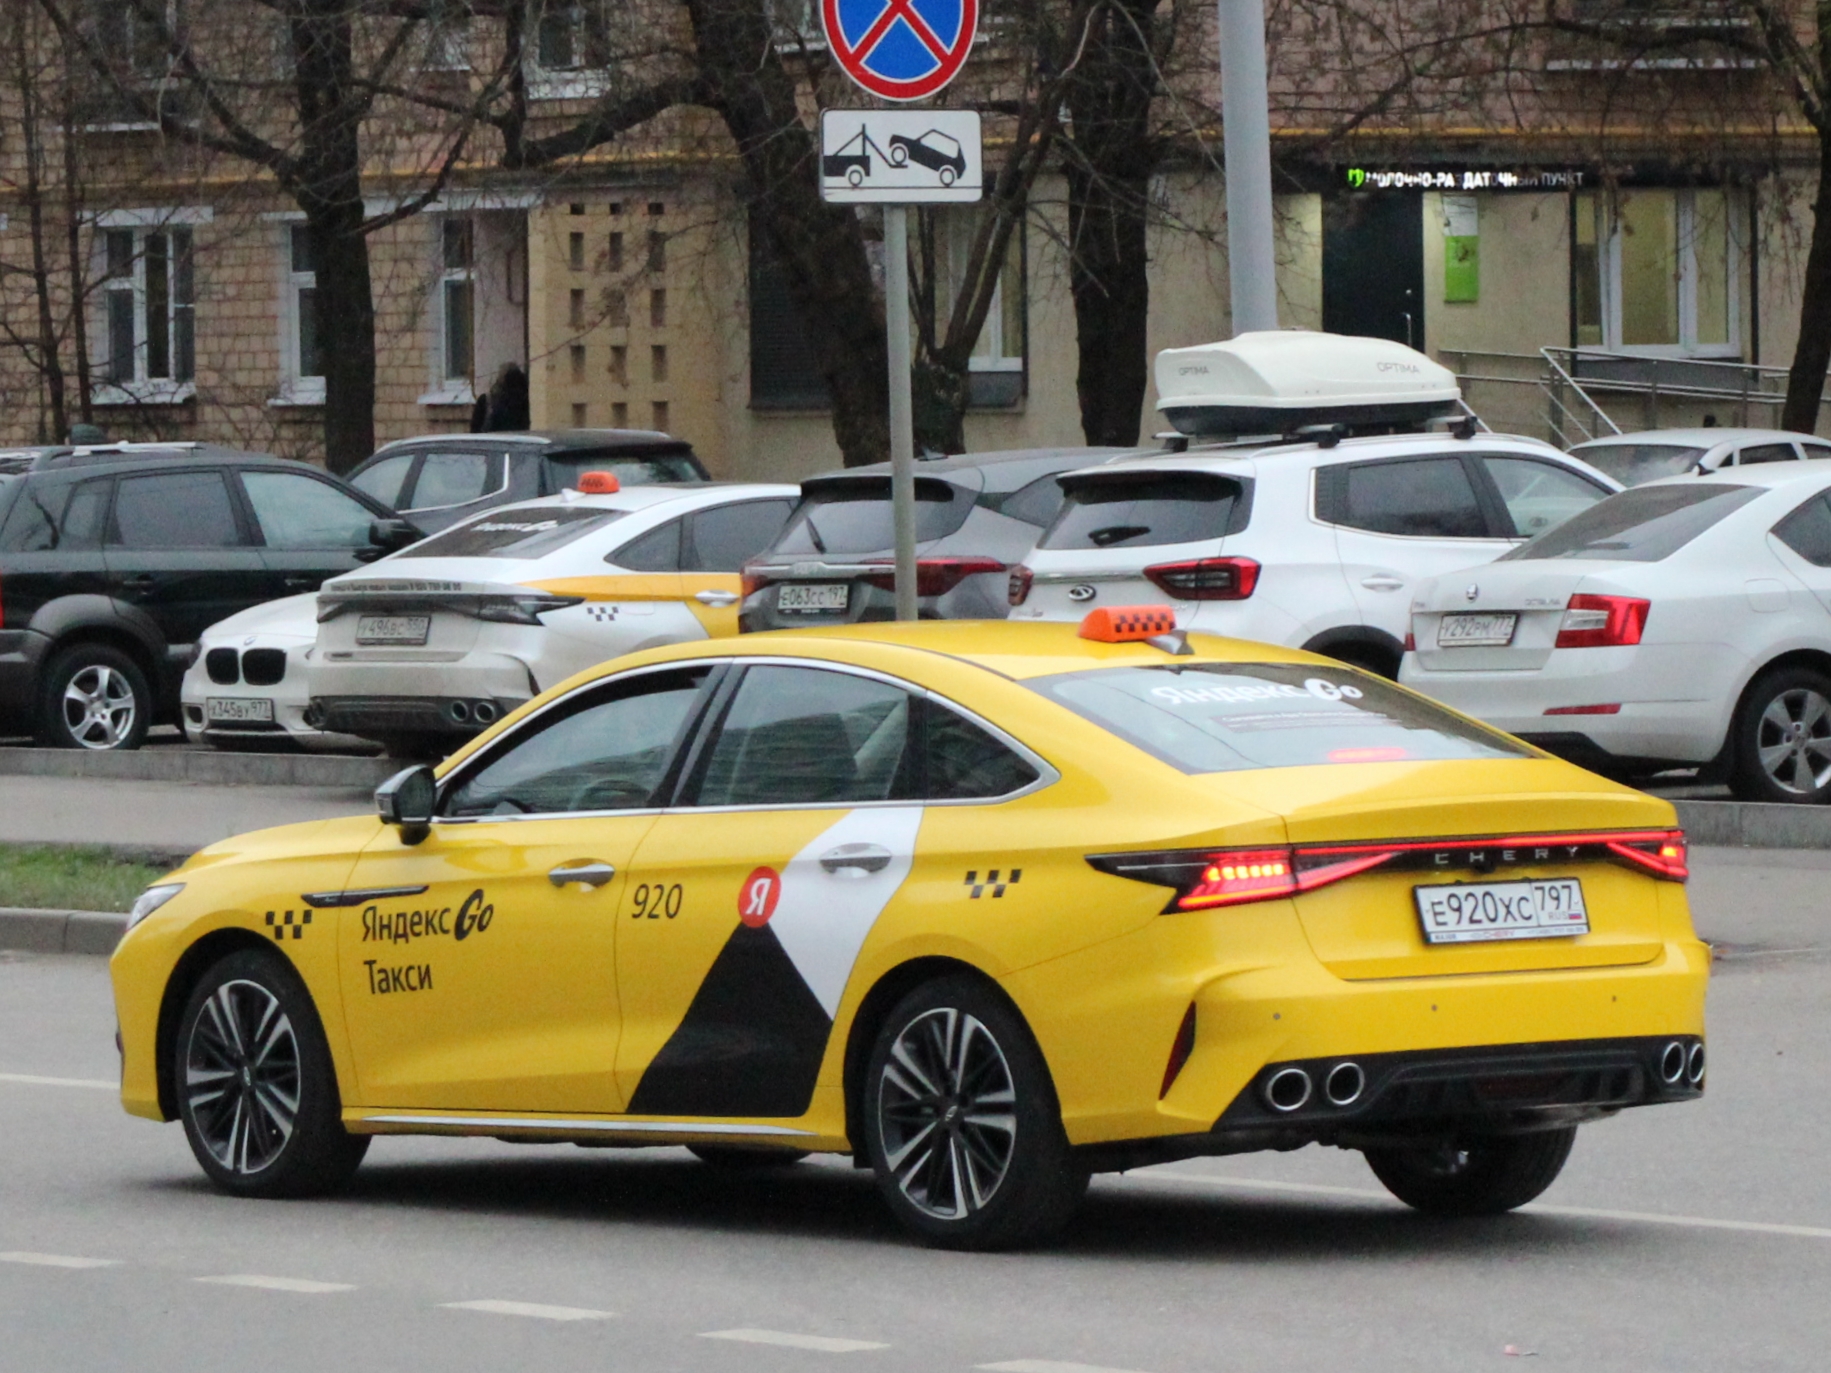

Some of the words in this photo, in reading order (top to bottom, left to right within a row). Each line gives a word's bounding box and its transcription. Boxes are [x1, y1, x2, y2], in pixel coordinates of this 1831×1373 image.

[1541, 172, 1583, 186] ПУНКТ
[1179, 366, 1209, 376] OPTIMA
[1377, 362, 1420, 374] OPTIMA
[827, 586, 845, 600] 197
[1150, 685, 1310, 705] Яндекс
[1304, 678, 1364, 701] Go
[1435, 846, 1578, 865] CHERY
[631, 884, 683, 919] 920
[745, 877, 772, 916] Я
[1431, 891, 1533, 926] Е920ХС
[1534, 885, 1573, 912] 797
[362, 906, 451, 945] Яндекс
[454, 888, 494, 941] Go
[1548, 911, 1568, 921] RUS
[363, 959, 433, 995] Такси
